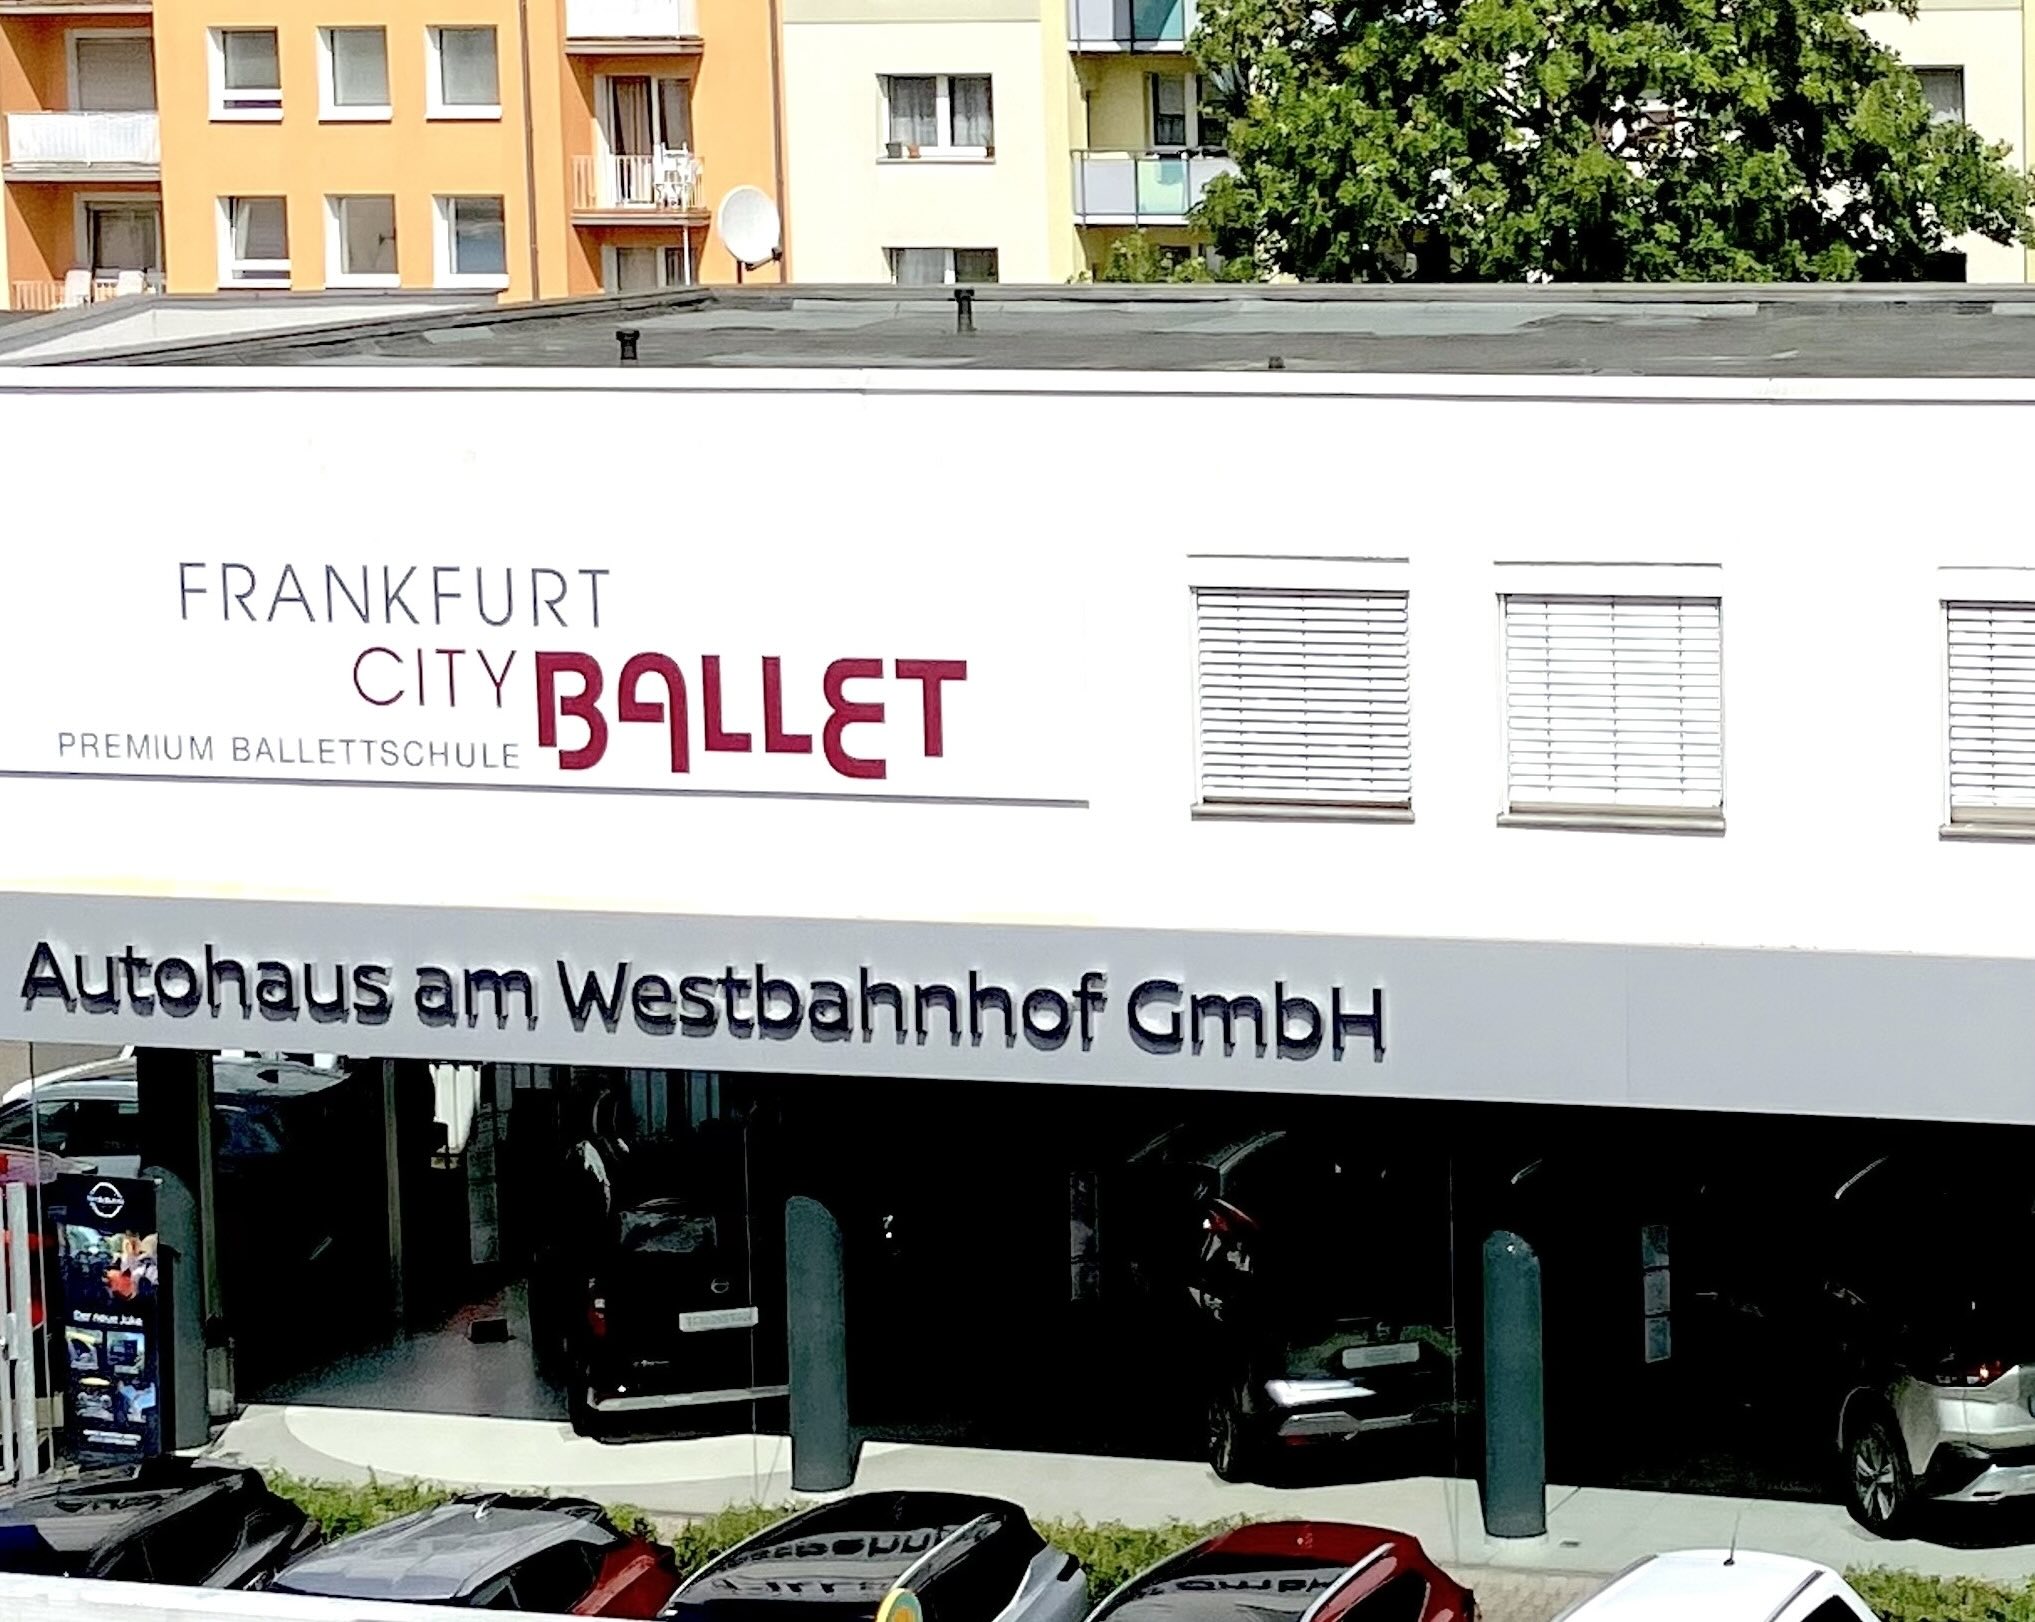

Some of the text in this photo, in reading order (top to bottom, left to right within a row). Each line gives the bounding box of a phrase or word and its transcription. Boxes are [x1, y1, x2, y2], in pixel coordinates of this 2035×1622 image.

[179, 563, 610, 628] FRANKFURT
[58, 732, 520, 769] PREMIUM BALLETTSCHULE
[353, 646, 967, 779] CITY BALLET
[21, 942, 1386, 1062] Autohaus am Westbahnhof GmbH
